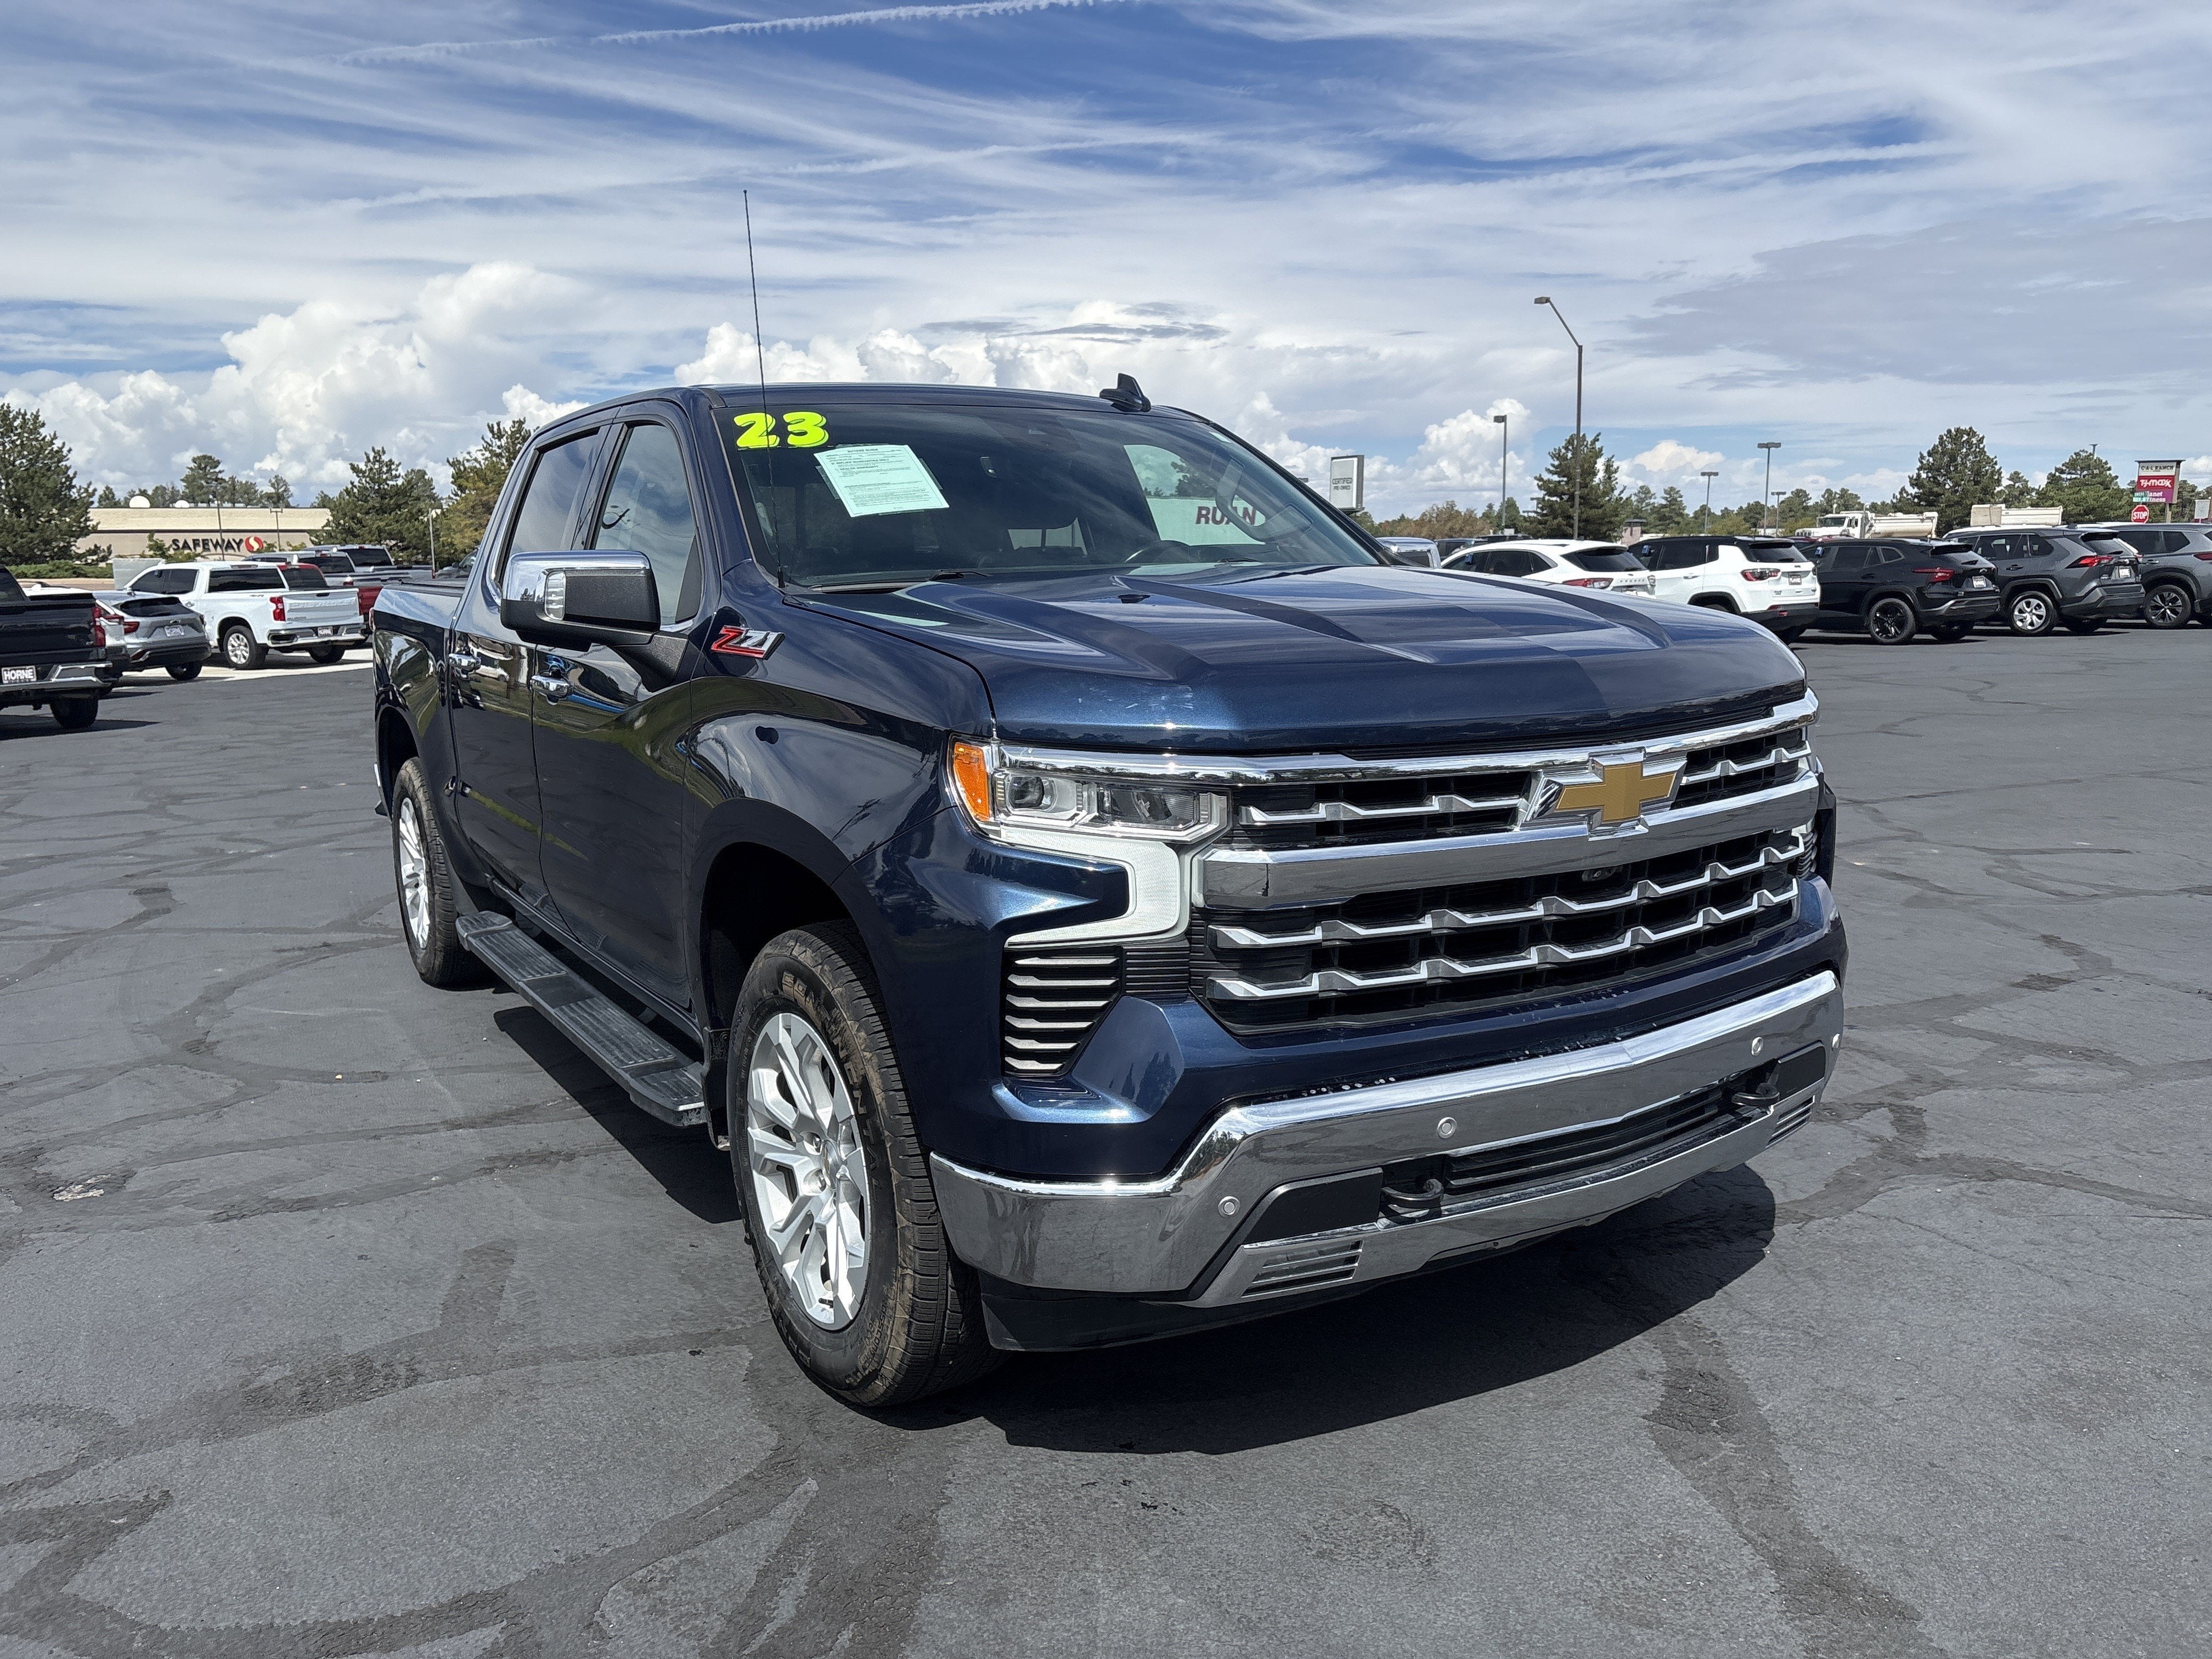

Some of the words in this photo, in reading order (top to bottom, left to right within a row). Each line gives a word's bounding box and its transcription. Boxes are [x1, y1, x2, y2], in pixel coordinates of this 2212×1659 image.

[733, 411, 829, 448] 23
[2133, 511, 2148, 520] STOP
[172, 538, 244, 552] SAFEWAY
[710, 625, 785, 660] Z71
[3, 669, 34, 680] HORNE
